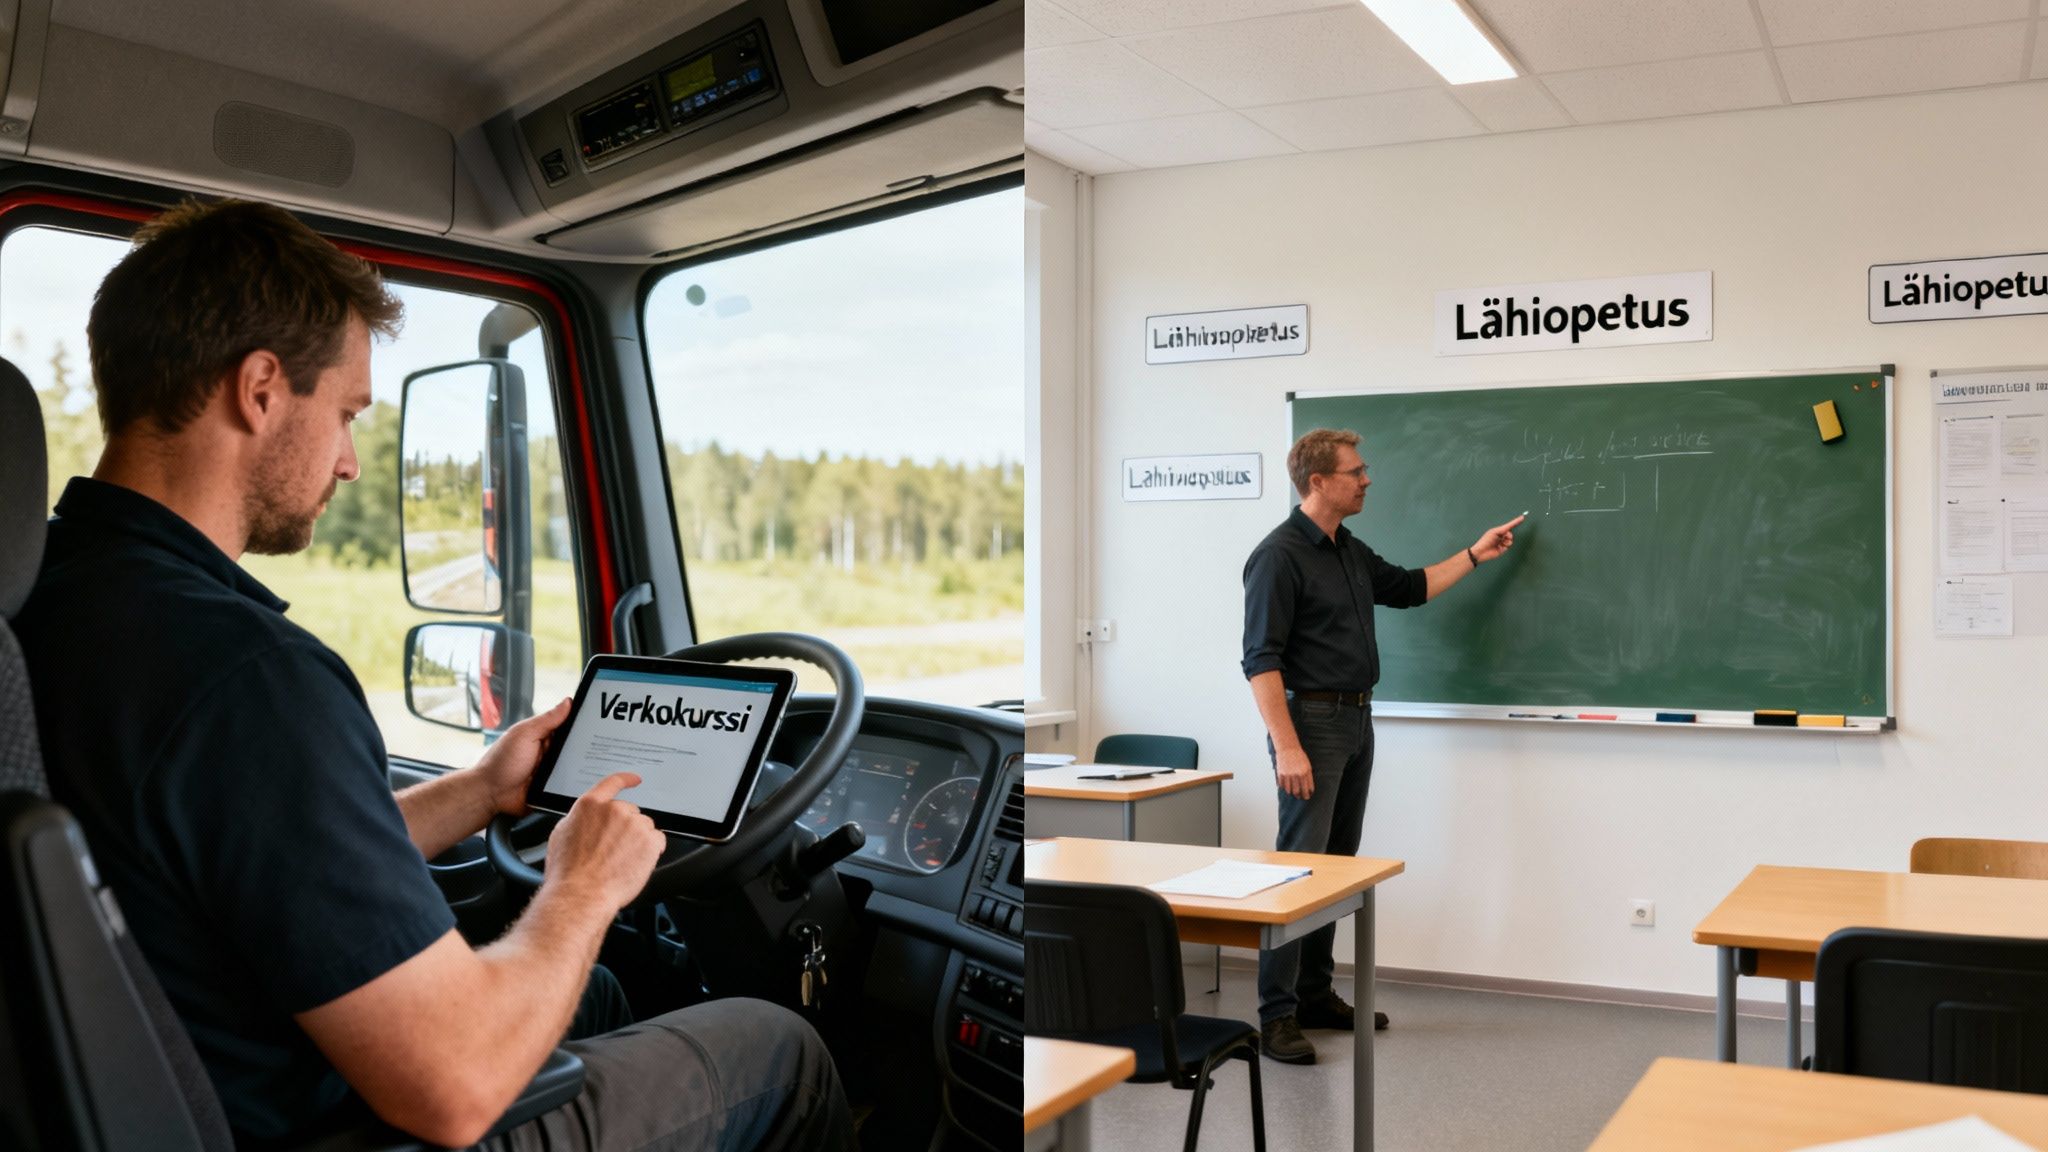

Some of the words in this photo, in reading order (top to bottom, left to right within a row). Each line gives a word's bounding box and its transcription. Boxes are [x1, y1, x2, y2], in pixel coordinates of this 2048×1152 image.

[1884, 271, 2048, 310] Lähiopetu
[1456, 294, 1690, 344] Lähiopetus
[600, 691, 753, 733] Verkokurssi
